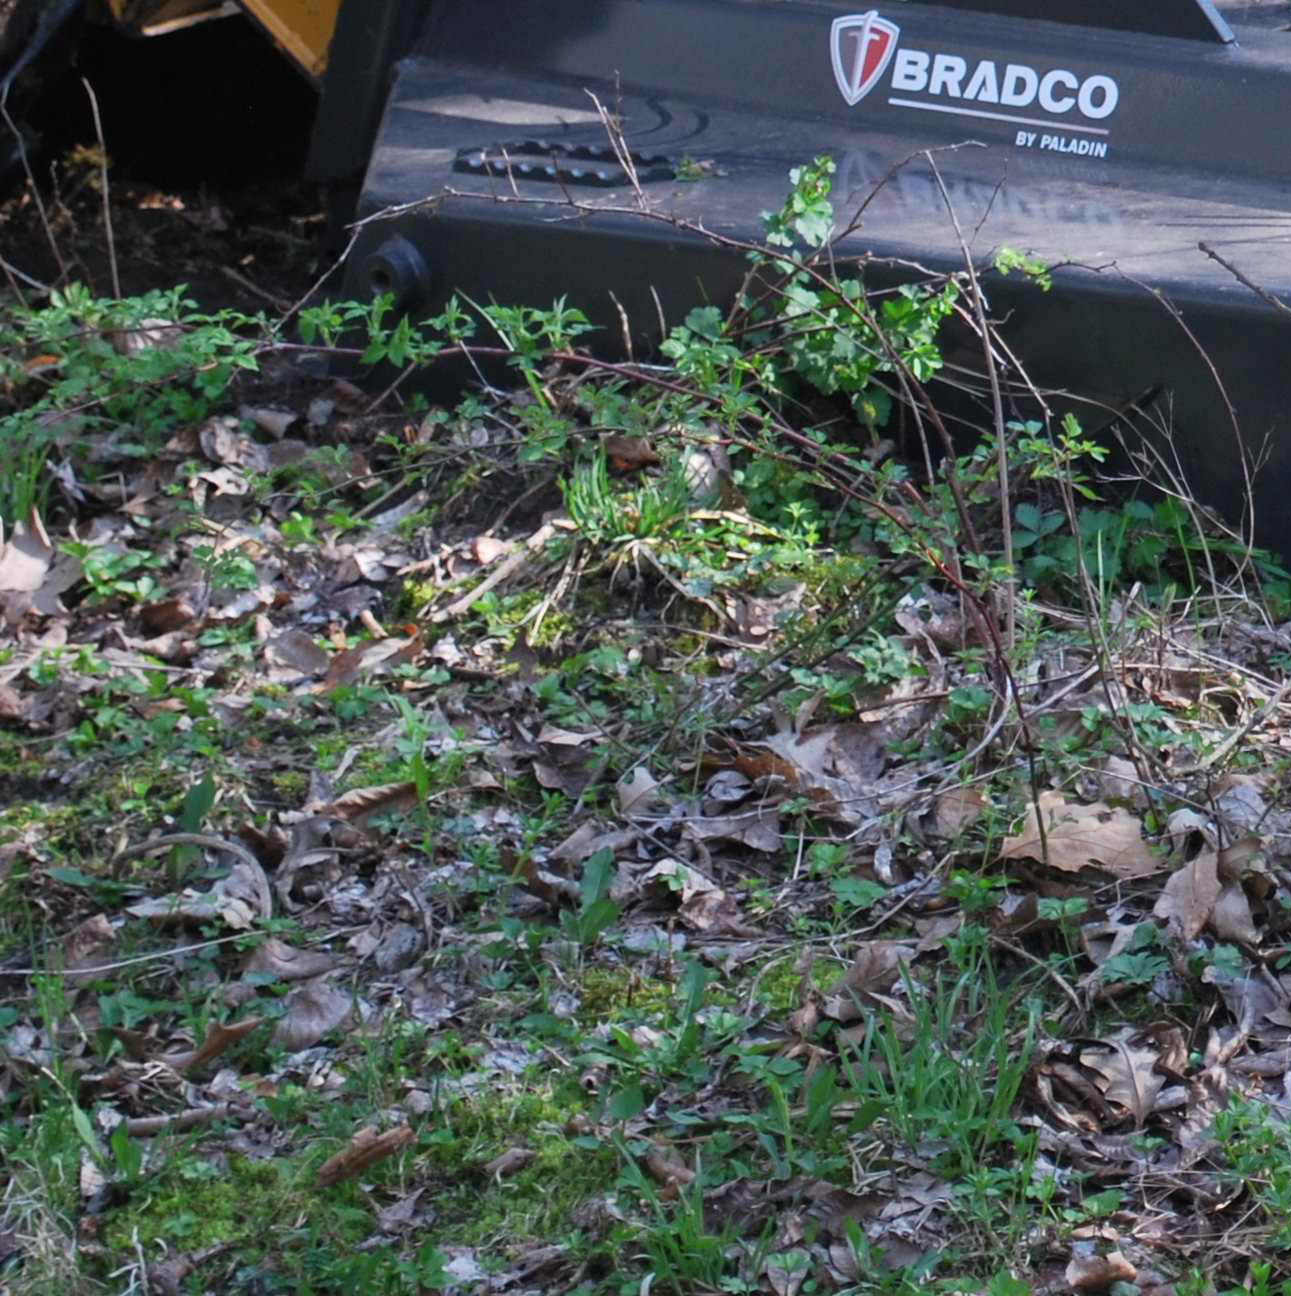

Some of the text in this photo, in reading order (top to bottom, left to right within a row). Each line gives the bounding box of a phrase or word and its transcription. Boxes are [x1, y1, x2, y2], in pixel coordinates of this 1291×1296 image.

[890, 48, 1120, 119] BRADCO
[1015, 130, 1108, 158] BY PALADIN
